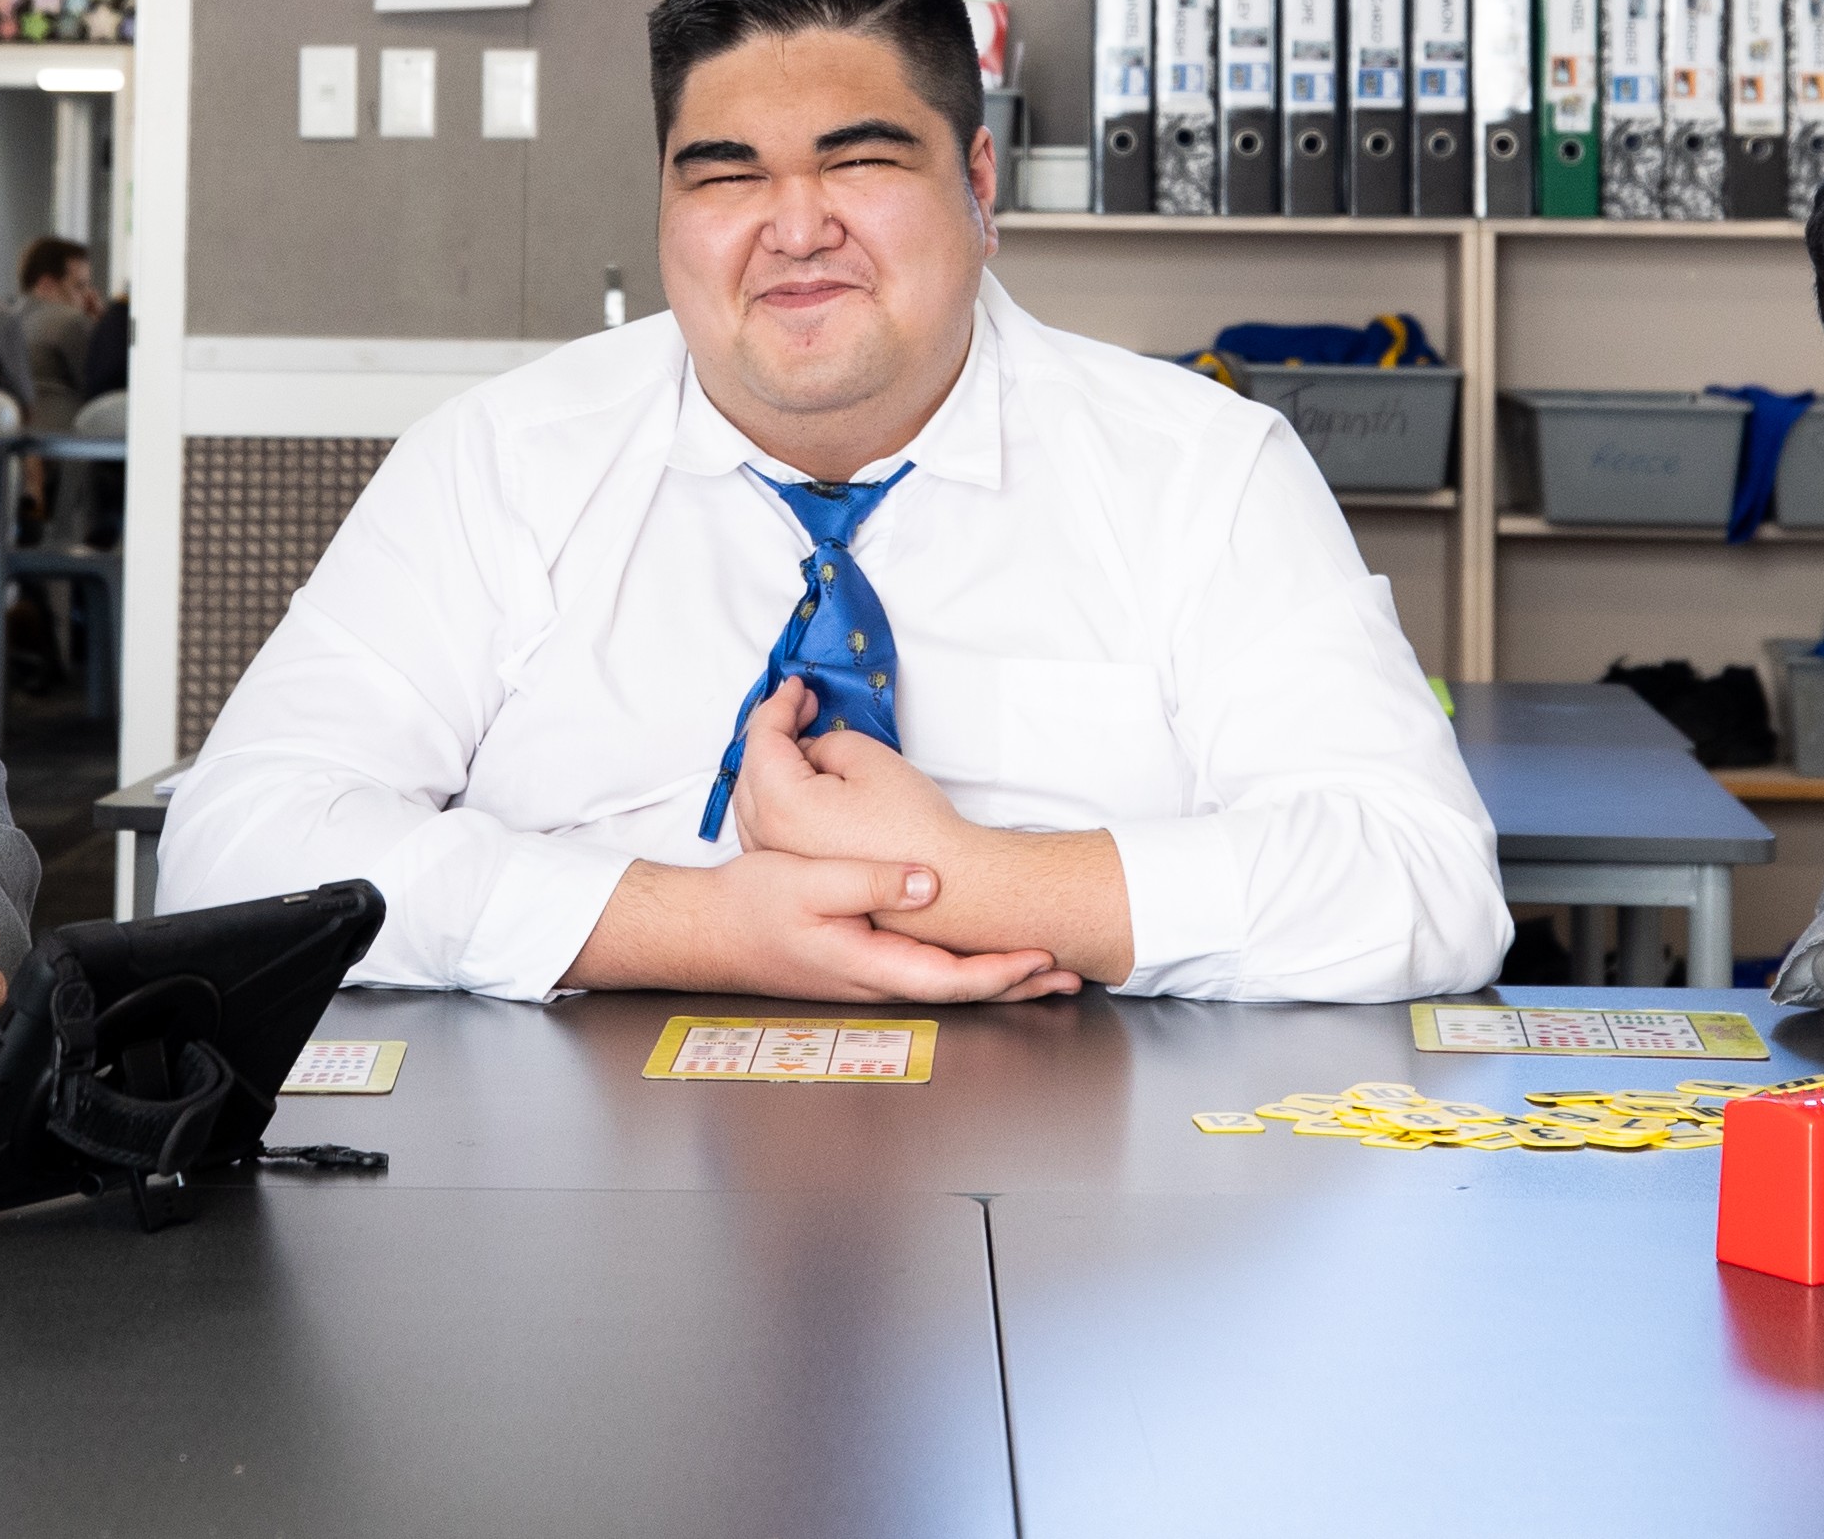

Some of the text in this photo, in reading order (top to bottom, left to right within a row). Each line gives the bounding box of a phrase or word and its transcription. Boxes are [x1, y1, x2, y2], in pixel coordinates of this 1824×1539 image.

[1359, 1087, 1413, 1099] 10
[1201, 1114, 1253, 1127] 12
[1402, 1114, 1440, 1125] 8
[1530, 1127, 1565, 1140] 3
